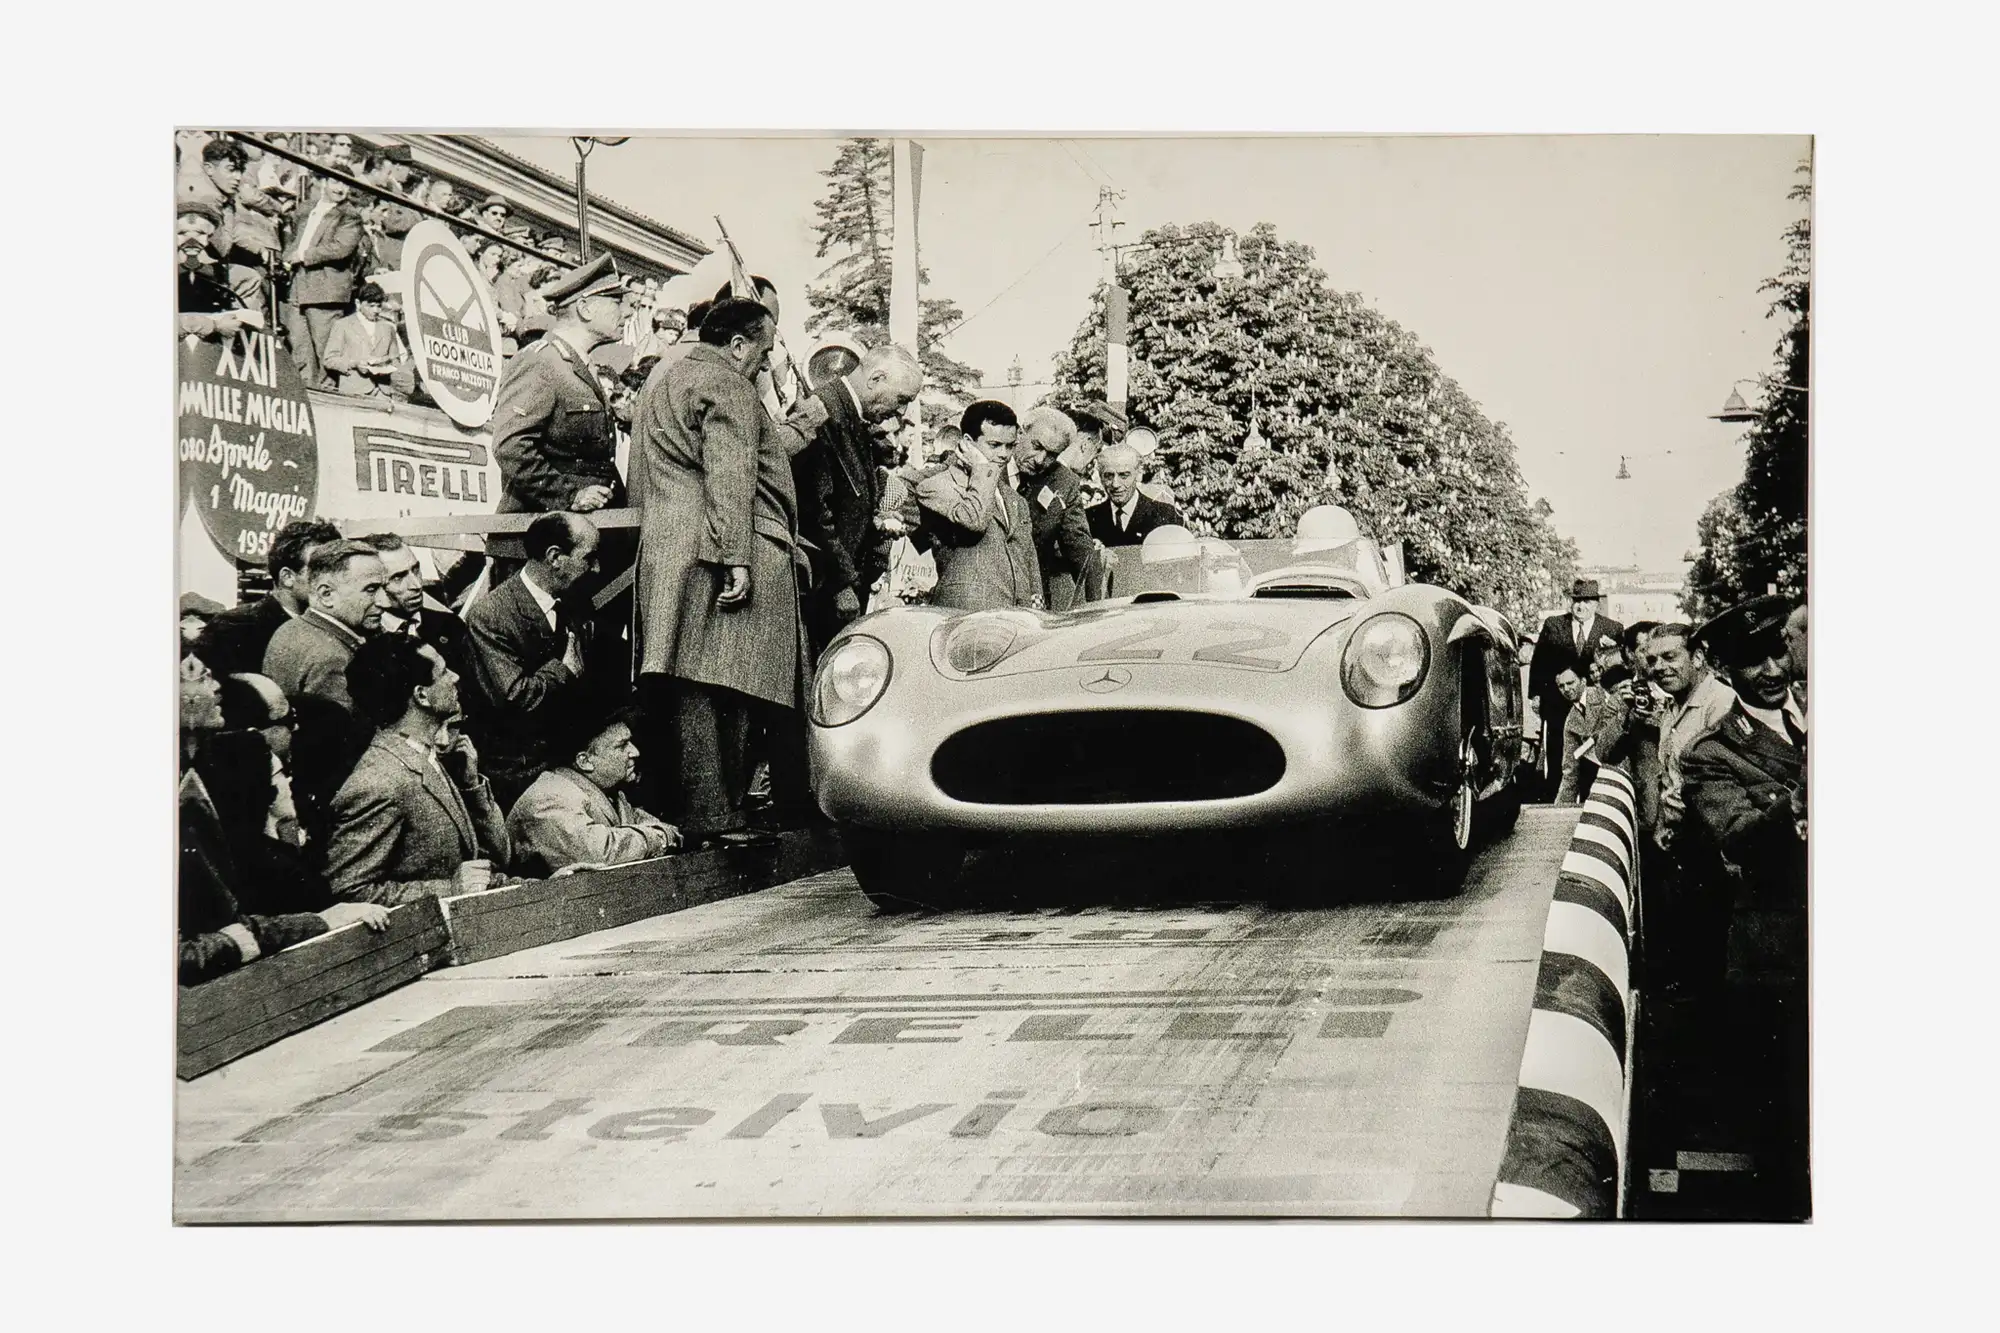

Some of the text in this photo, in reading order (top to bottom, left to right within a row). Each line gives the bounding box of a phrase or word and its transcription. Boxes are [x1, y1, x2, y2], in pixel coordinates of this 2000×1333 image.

[442, 322, 469, 345] CLUB
[180, 380, 313, 437] MILLE MIGLIA
[206, 423, 273, 480] Aprile
[353, 426, 488, 503] PIRELLI
[210, 473, 308, 531] 1 Maggio
[1077, 616, 1292, 670] 22
[364, 988, 1423, 1052] PIRELLI
[354, 1091, 1168, 1142] stelvio
